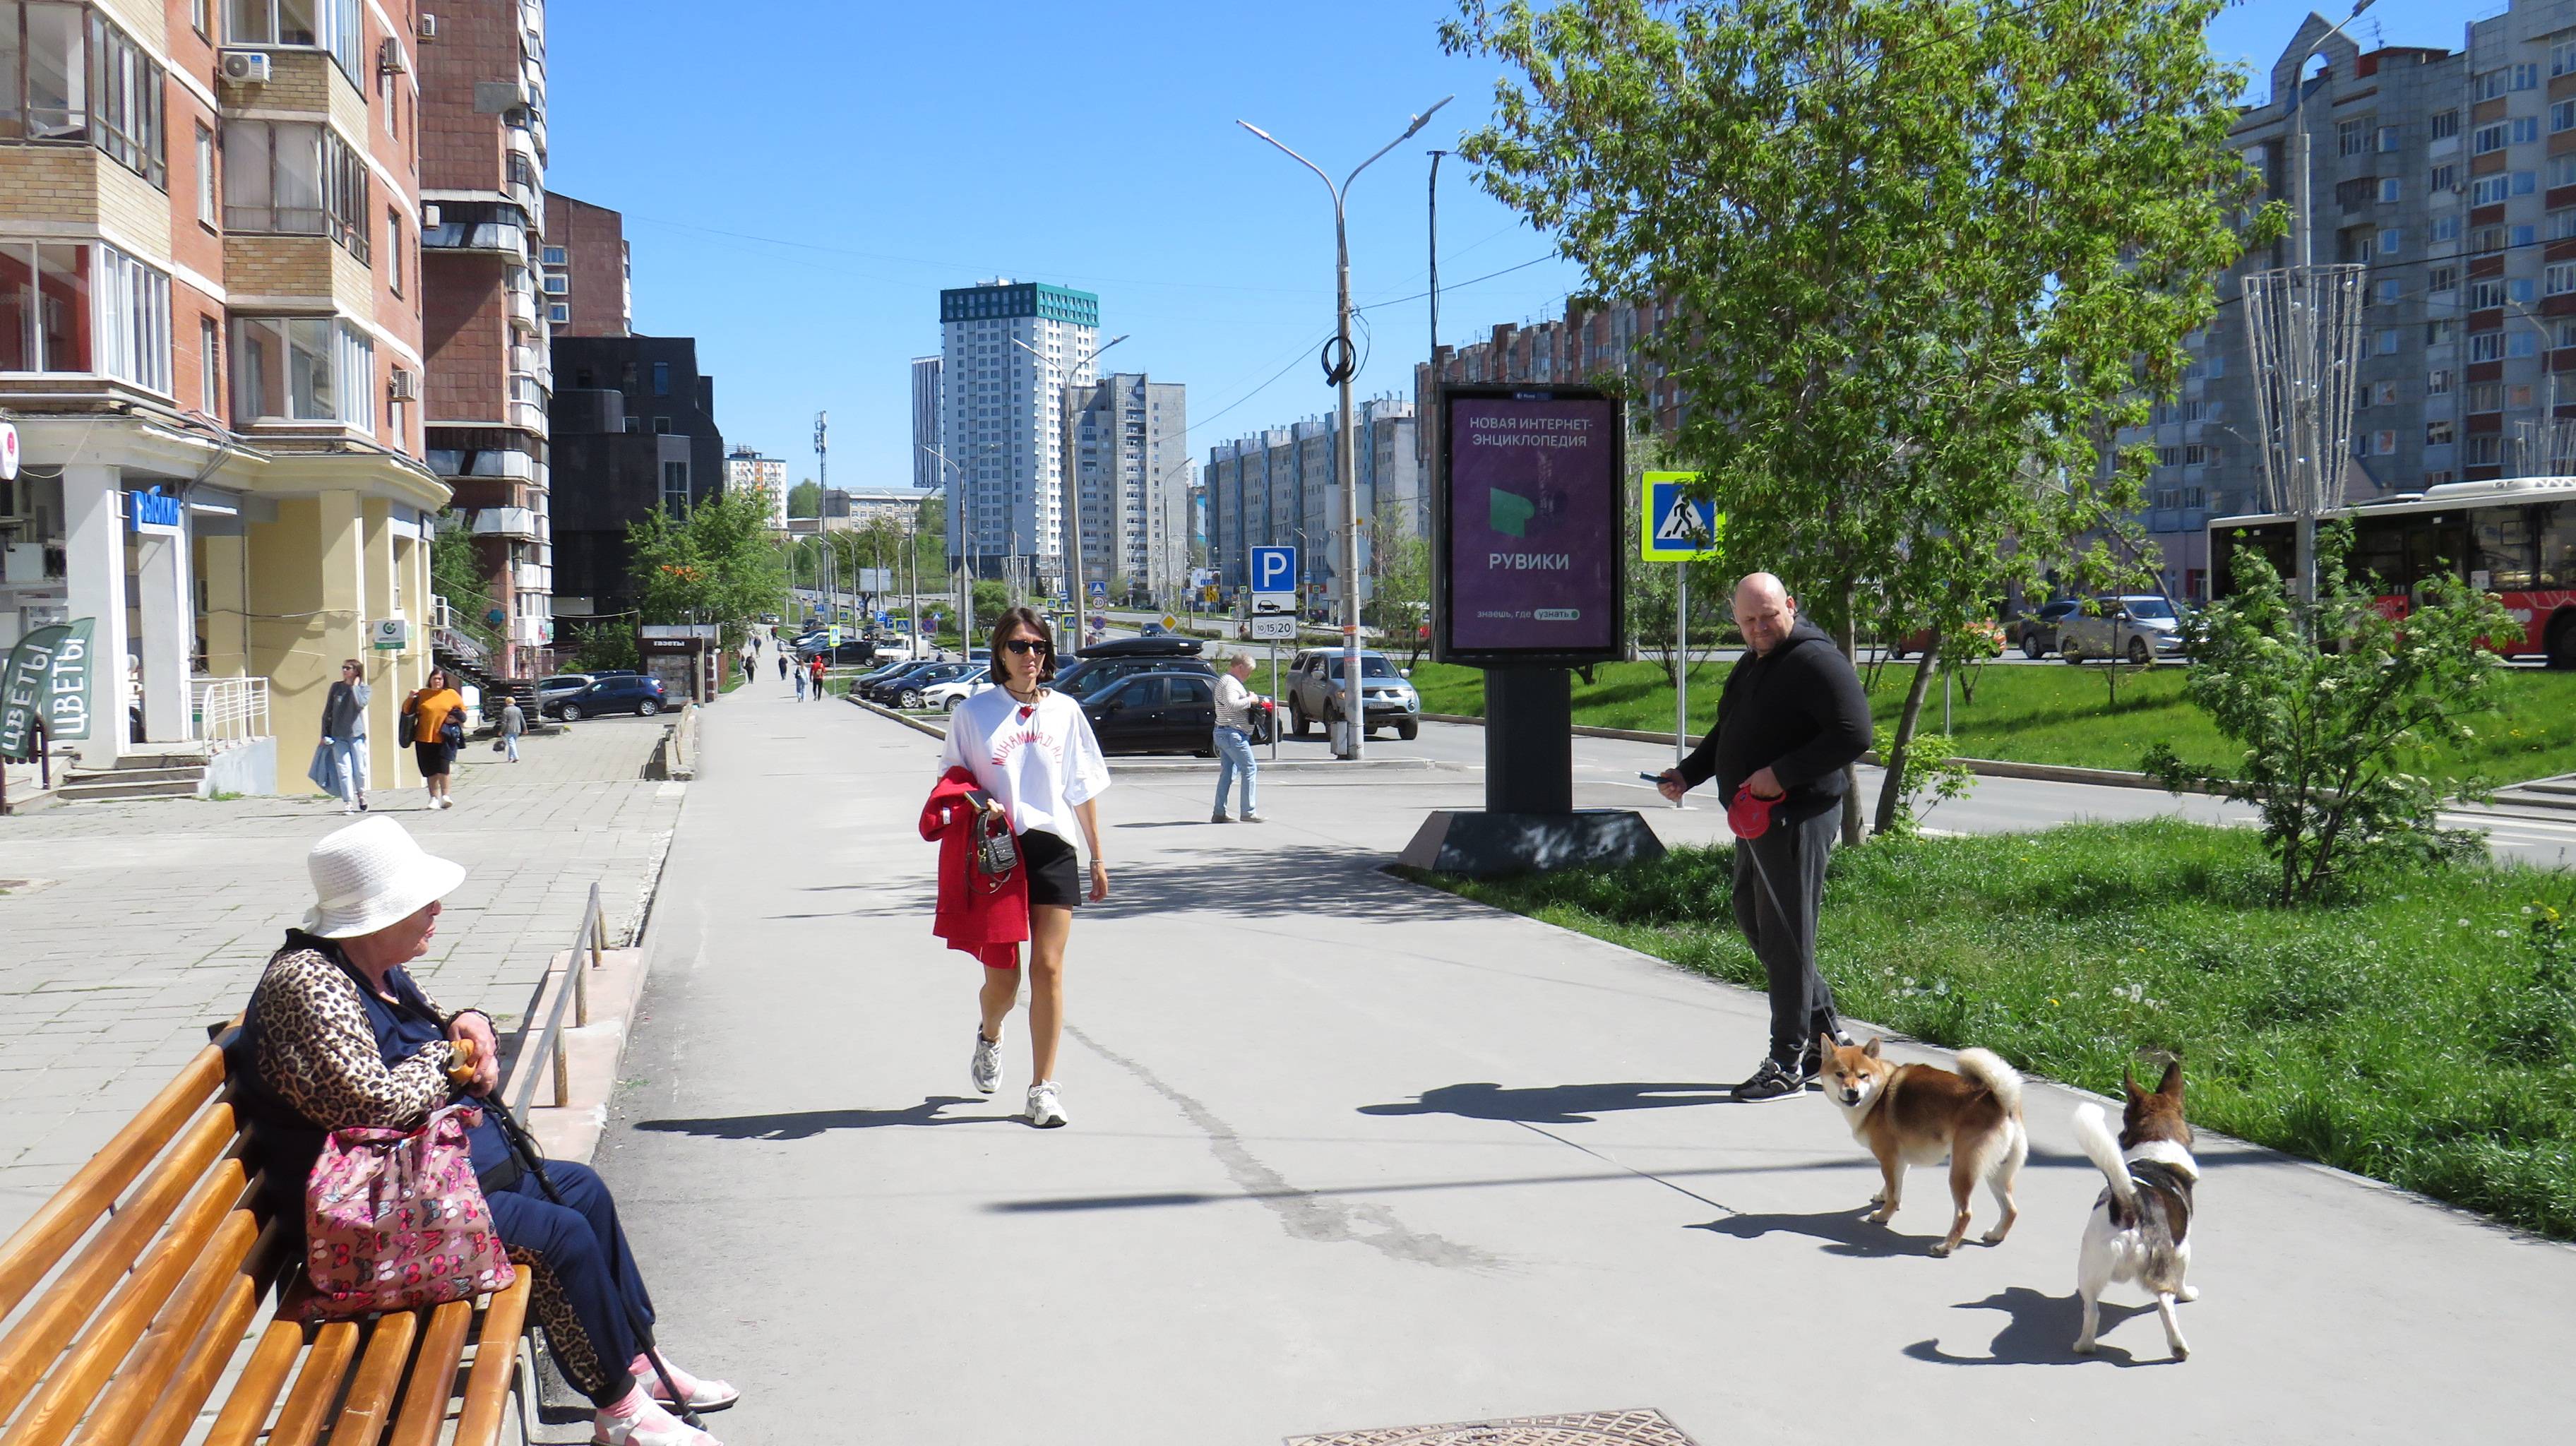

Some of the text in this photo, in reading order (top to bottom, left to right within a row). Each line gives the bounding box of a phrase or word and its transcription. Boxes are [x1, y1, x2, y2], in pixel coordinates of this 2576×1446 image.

[1469, 417, 1593, 430] НОВАЯ ИНТЕРНЕТ-
[1472, 434, 1587, 448] ЭНЦИКЛОПЕДИЯ
[1263, 552, 1287, 587] P
[1489, 553, 1569, 570] РУВИКИ
[1477, 610, 1570, 620] знаешь, где узнать
[1266, 623, 1275, 632] 15
[1278, 623, 1291, 633] 20
[52, 638, 89, 735] ЦВЕТЫ
[2, 643, 53, 751] ЦВЕТЫ
[991, 730, 1054, 766] MUHAMMAD
